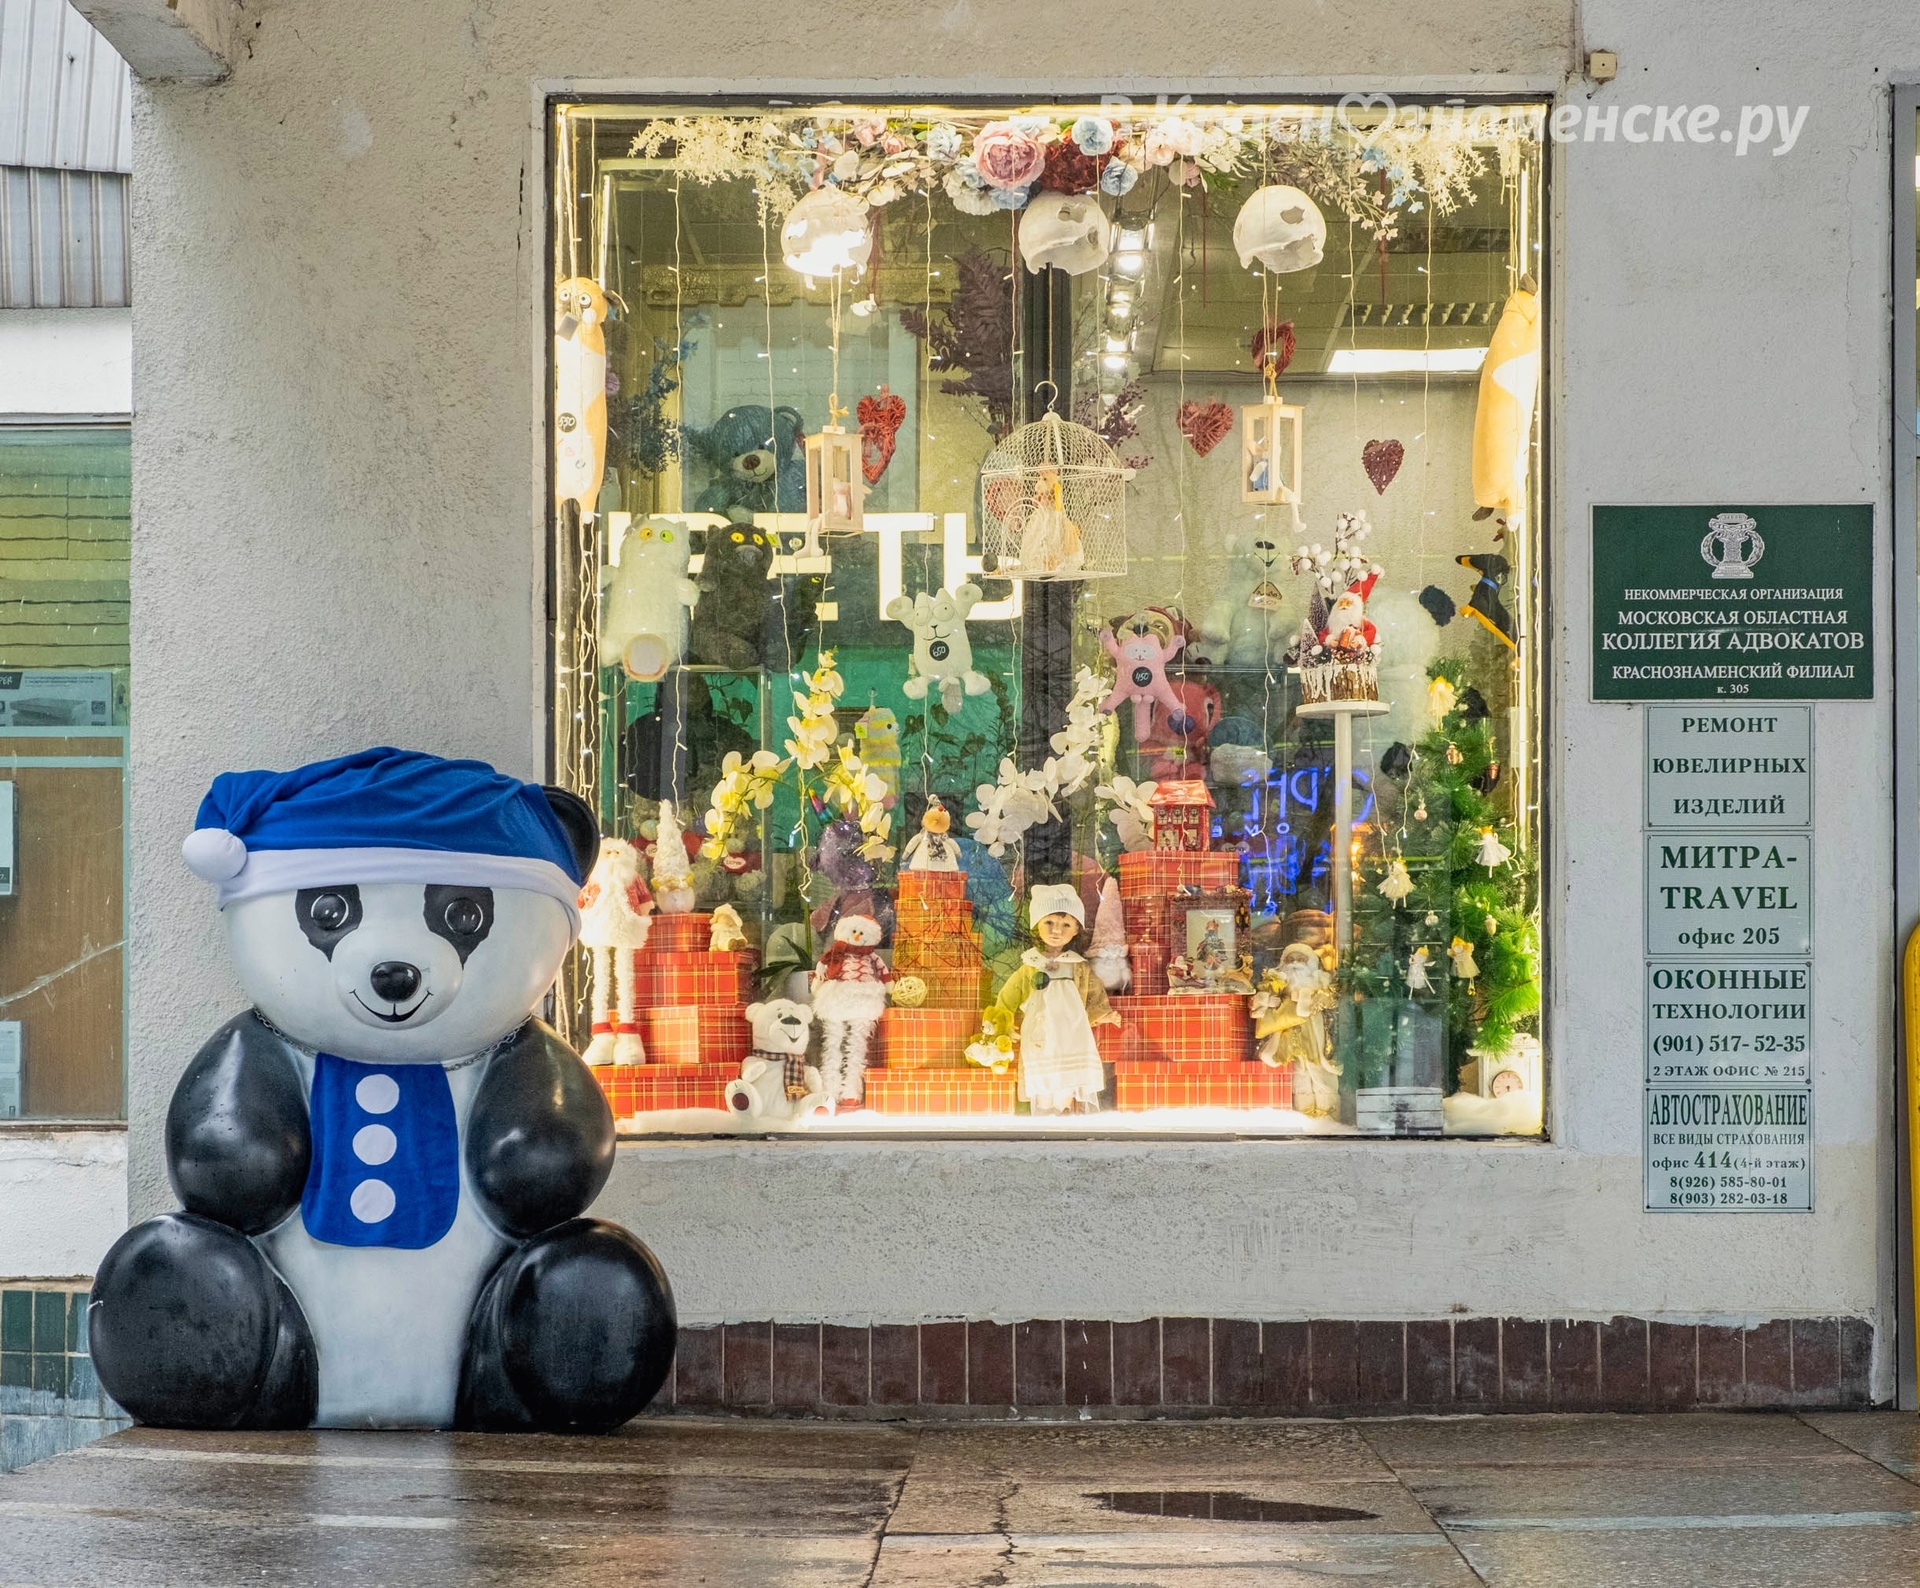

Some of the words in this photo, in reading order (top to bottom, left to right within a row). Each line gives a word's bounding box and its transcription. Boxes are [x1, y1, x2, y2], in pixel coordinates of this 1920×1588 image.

[1625, 589, 1747, 600] НЕКОММЕРЧЕСКАЯ
[1750, 589, 1843, 600] ОРГАНИЗАЦИЯ
[1618, 611, 1739, 624] МОСКОВСКАЯ
[1744, 611, 1848, 624] ОБЛАСТНАЯ
[1602, 632, 1720, 650] КОЛЛЕГИЯ
[1727, 632, 1864, 653] АДВОКАТОВ
[1612, 662, 1782, 678] КРАСНОЗНАМЕНСКИЙ
[1787, 665, 1854, 679] ФИЛИАЛ
[1730, 684, 1749, 693] 305
[1682, 718, 1777, 732] РЕМОНТ
[1653, 758, 1806, 773] ЮВЕЛИРНЫХ
[1674, 795, 1785, 816] ИЗДЕЛИЙ
[1661, 846, 1797, 868] МИТРА-
[1660, 887, 1797, 909] TRAVEL
[1678, 928, 1735, 948] офис
[1743, 927, 1779, 944] 205
[1653, 970, 1806, 989] ОКОННЫЕ
[1652, 1004, 1805, 1019] ТЕХНОЛОГИИ
[1653, 1035, 1703, 1056] (901)
[1654, 1066, 1660, 1076] 2
[1665, 1066, 1708, 1076] ЭТАЖ
[1713, 1066, 1759, 1076] ОФИС
[1784, 1066, 1805, 1076] 215
[1650, 1094, 1807, 1125] АВТОСТРАХОВАНИЕ
[1654, 1134, 1675, 1144] ВСЕ
[1679, 1134, 1713, 1146] ВИДЫ
[1717, 1133, 1805, 1145] СТРАХОВАНИЯ
[1653, 1157, 1688, 1171] офис
[1670, 1177, 1715, 1190] 8(926)
[1721, 1176, 1786, 1187] 585-80-01
[1670, 1193, 1715, 1206] 8(903)
[1721, 1193, 1787, 1204] 282-03-18
